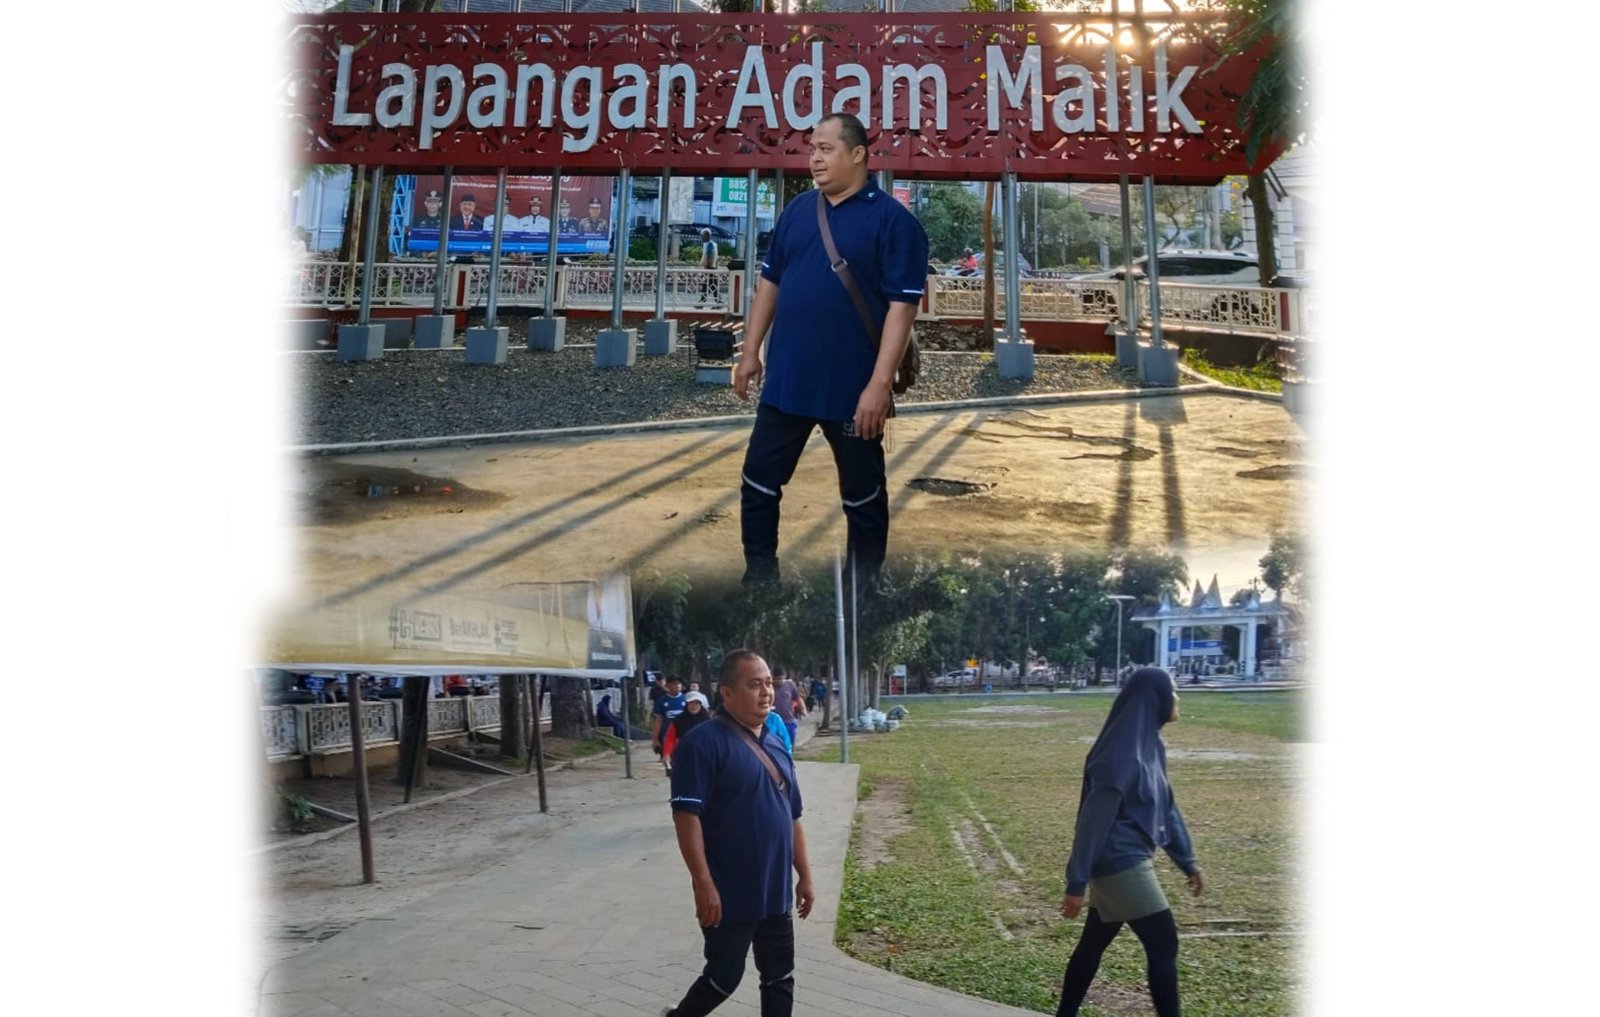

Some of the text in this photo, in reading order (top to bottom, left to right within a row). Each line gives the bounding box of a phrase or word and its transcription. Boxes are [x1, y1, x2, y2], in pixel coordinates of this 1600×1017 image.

[333, 41, 1204, 153] Lapangan Adam Malik
